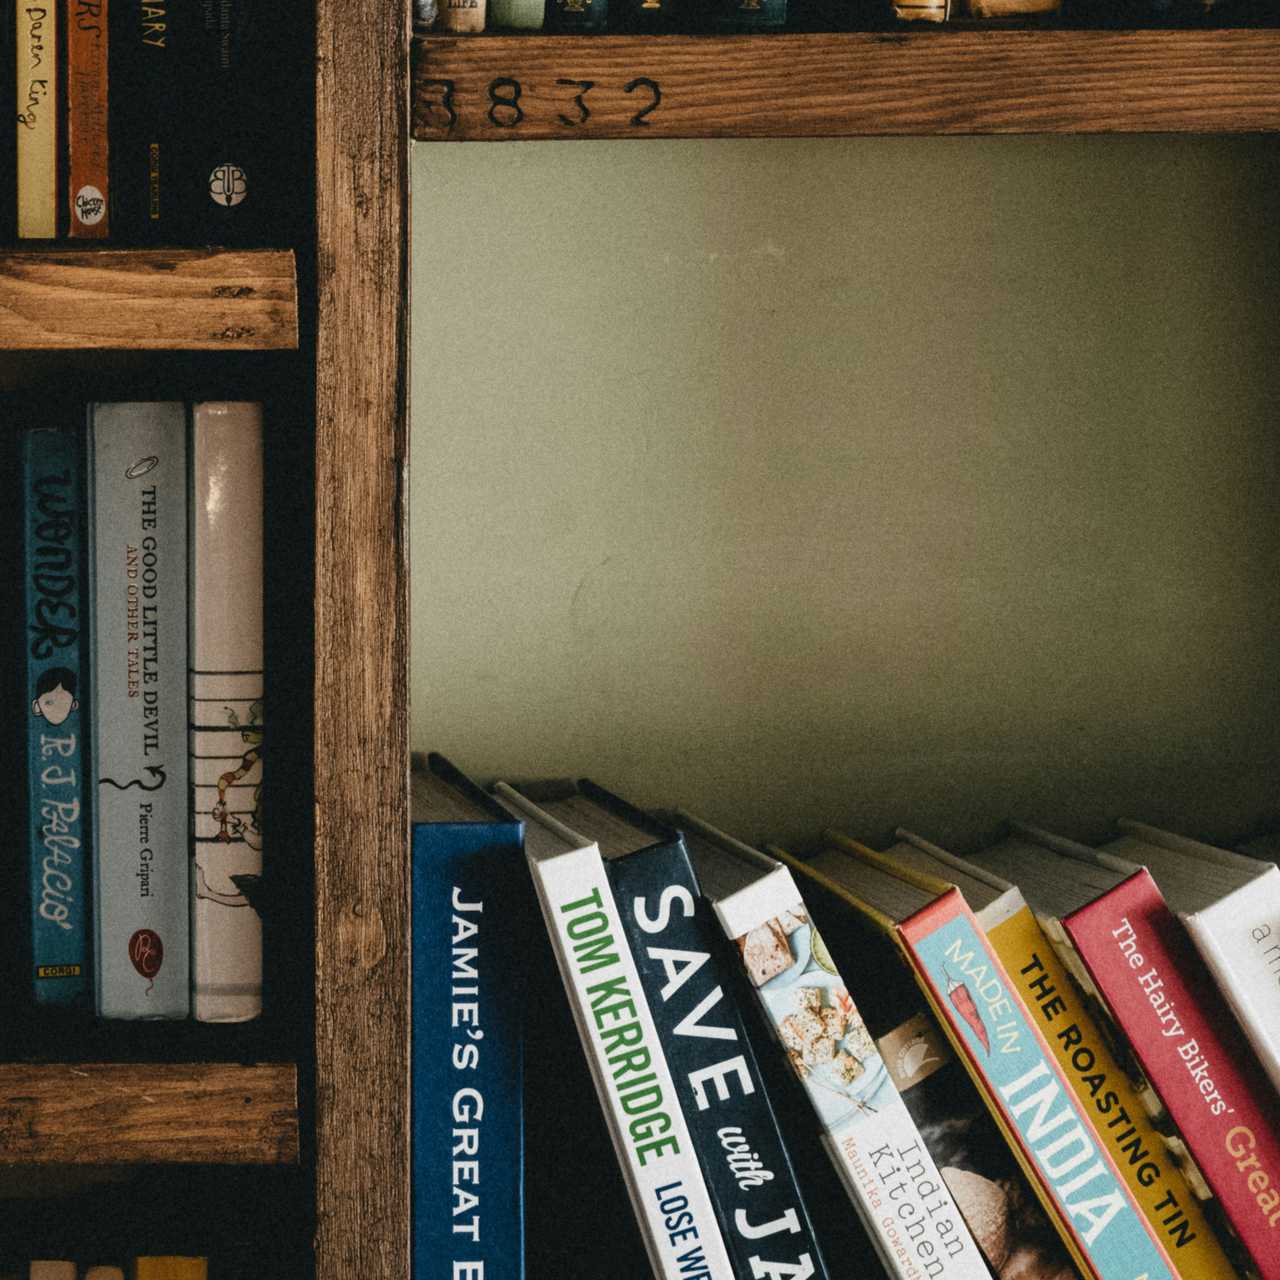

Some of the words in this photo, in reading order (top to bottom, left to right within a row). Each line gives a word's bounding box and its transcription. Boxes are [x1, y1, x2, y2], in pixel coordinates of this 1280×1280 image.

[141, 486, 156, 530] THE
[141, 537, 157, 599] GOOD
[143, 607, 157, 684] LITTLE
[143, 691, 158, 755] DEVIL
[138, 803, 152, 844] Pierre
[136, 848, 155, 897] Gripari
[560, 888, 619, 973] TOM
[452, 886, 484, 1070] JAMIE'S
[586, 977, 683, 1167] KERRIDGE
[634, 884, 755, 1112] SAVE
[716, 1127, 758, 1191] with
[452, 1088, 484, 1242] GREAT
[1000, 1061, 1127, 1246] INDIA
